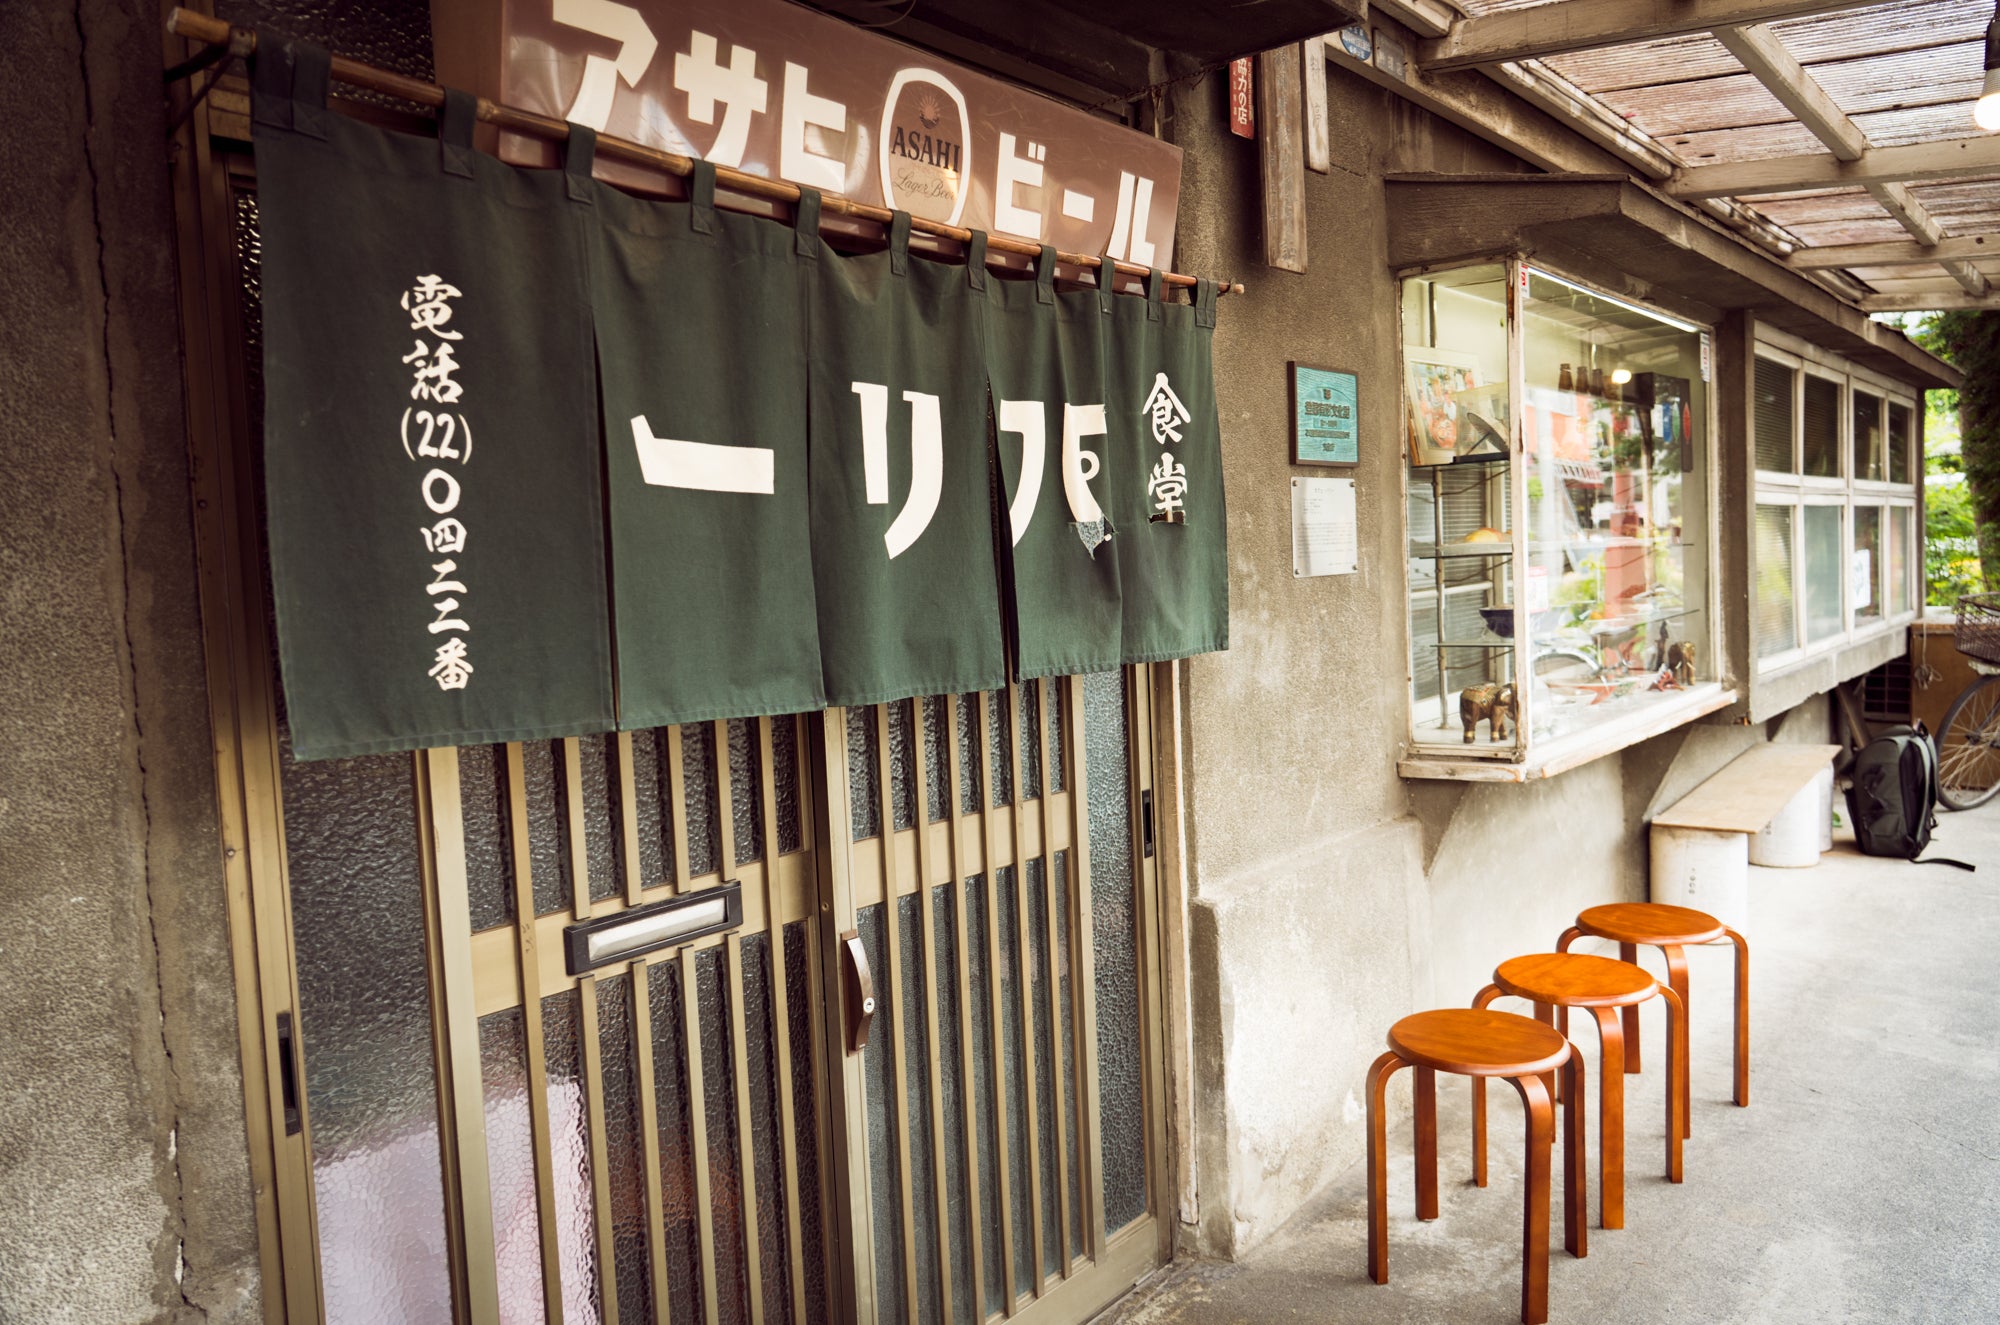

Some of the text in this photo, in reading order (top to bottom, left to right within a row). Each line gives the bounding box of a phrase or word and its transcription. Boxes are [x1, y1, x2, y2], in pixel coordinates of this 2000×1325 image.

[552, 0, 847, 194] アサヒ
[995, 132, 1157, 267] ビール
[891, 126, 961, 173] ASAHI
[893, 168, 929, 198] Lager
[1142, 372, 1192, 523] 食堂
